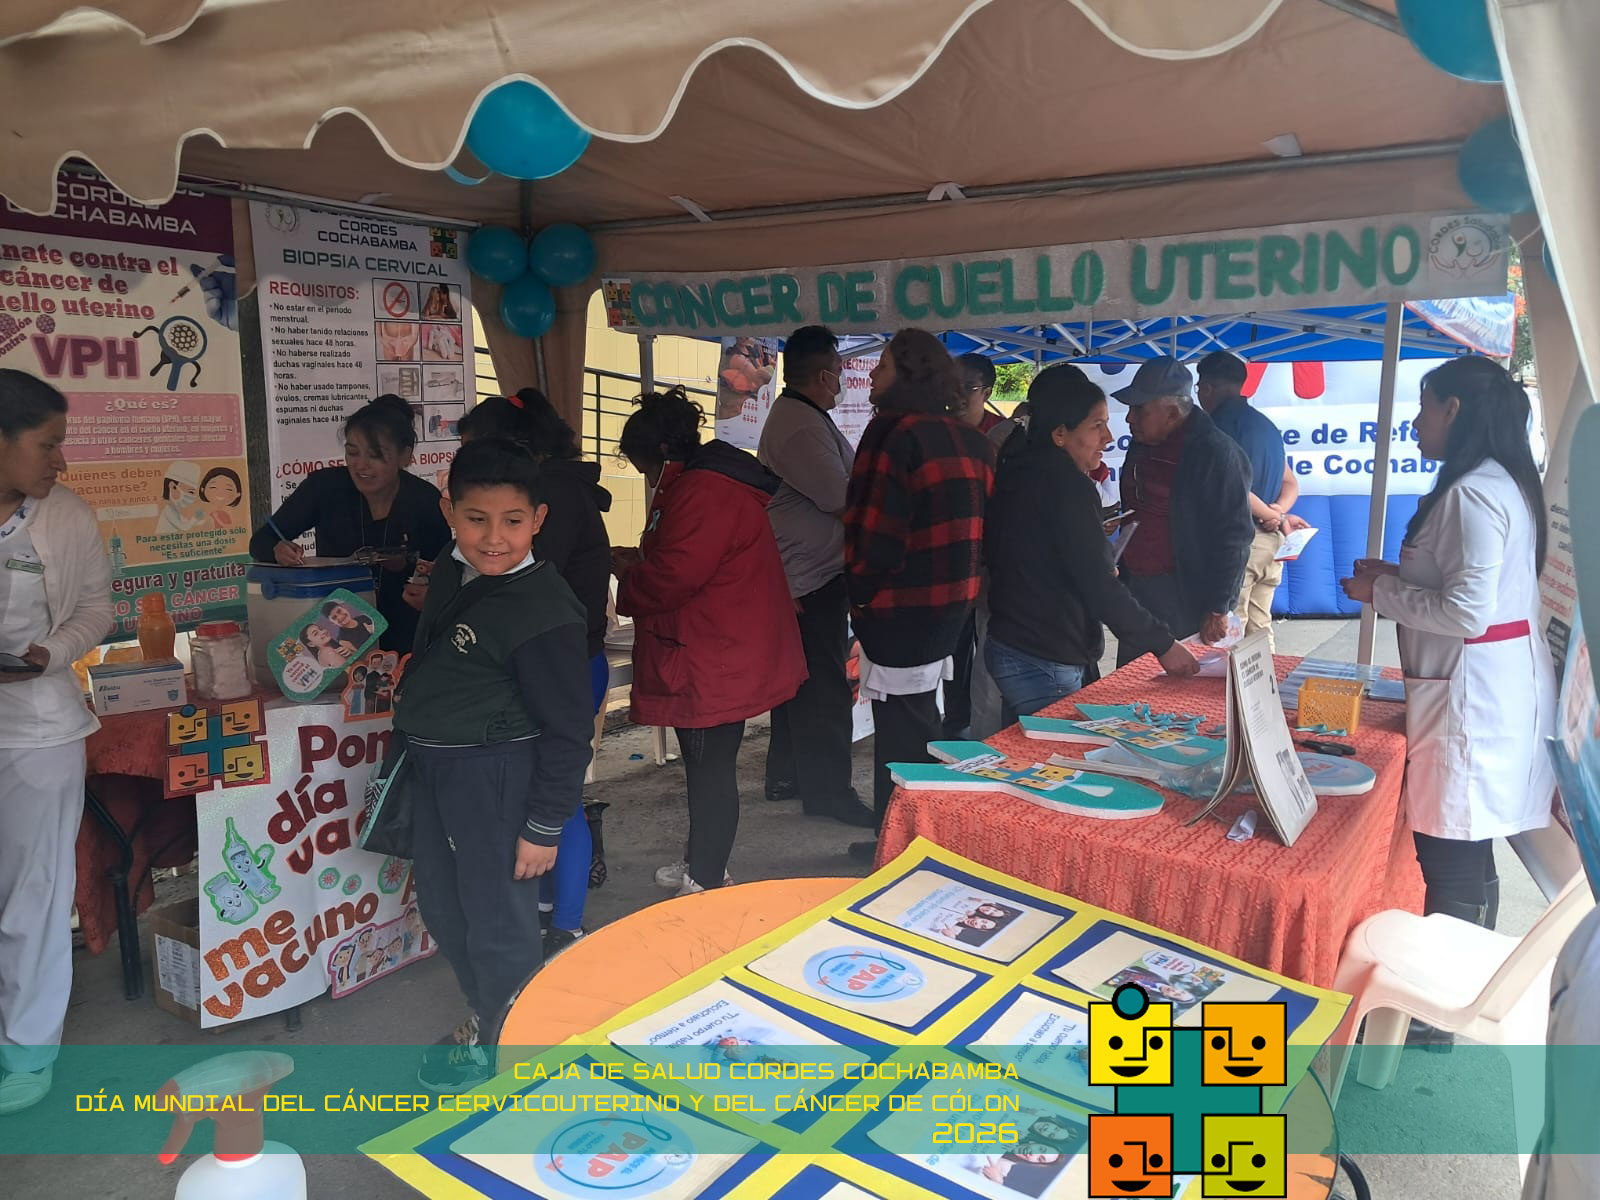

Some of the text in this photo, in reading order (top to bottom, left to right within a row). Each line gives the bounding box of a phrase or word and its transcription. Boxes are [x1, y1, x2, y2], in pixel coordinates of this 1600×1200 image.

[339, 219, 397, 236] CORDES
[318, 231, 418, 251] COCHABAMBA
[0, 243, 179, 276] nate contra el
[283, 248, 448, 277] BIOPSIA CERVICAL
[98, 274, 128, 294] de
[630, 273, 804, 329] CANCER
[817, 271, 879, 323] DE
[895, 249, 1104, 320] CUELLO
[1131, 225, 1421, 306] UTERINO
[269, 280, 359, 300] REQUISITOS:
[61, 296, 155, 320] uterino
[274, 303, 284, 311] No
[287, 326, 308, 334] haber
[334, 328, 368, 336] relaciones
[306, 338, 323, 346] hace
[31, 335, 140, 378] VPH
[288, 349, 318, 357] haberse
[302, 361, 335, 369] vaginales
[275, 405, 308, 414] espumas
[276, 416, 310, 425] vaginales
[312, 415, 329, 423] hace
[1311, 423, 1348, 444] de
[120, 468, 162, 479] deben
[136, 535, 157, 543] Para
[160, 533, 183, 541] estar
[186, 529, 228, 539] protegido
[149, 537, 236, 552] necesitas una dosis
[111, 561, 246, 595] egura y gratuita
[171, 585, 239, 608] CÁNCER
[268, 775, 348, 845] día
[203, 910, 297, 981] me
[203, 893, 379, 1019] vacuno
[847, 963, 889, 991] PAP
[588, 1132, 648, 1178] PAP
